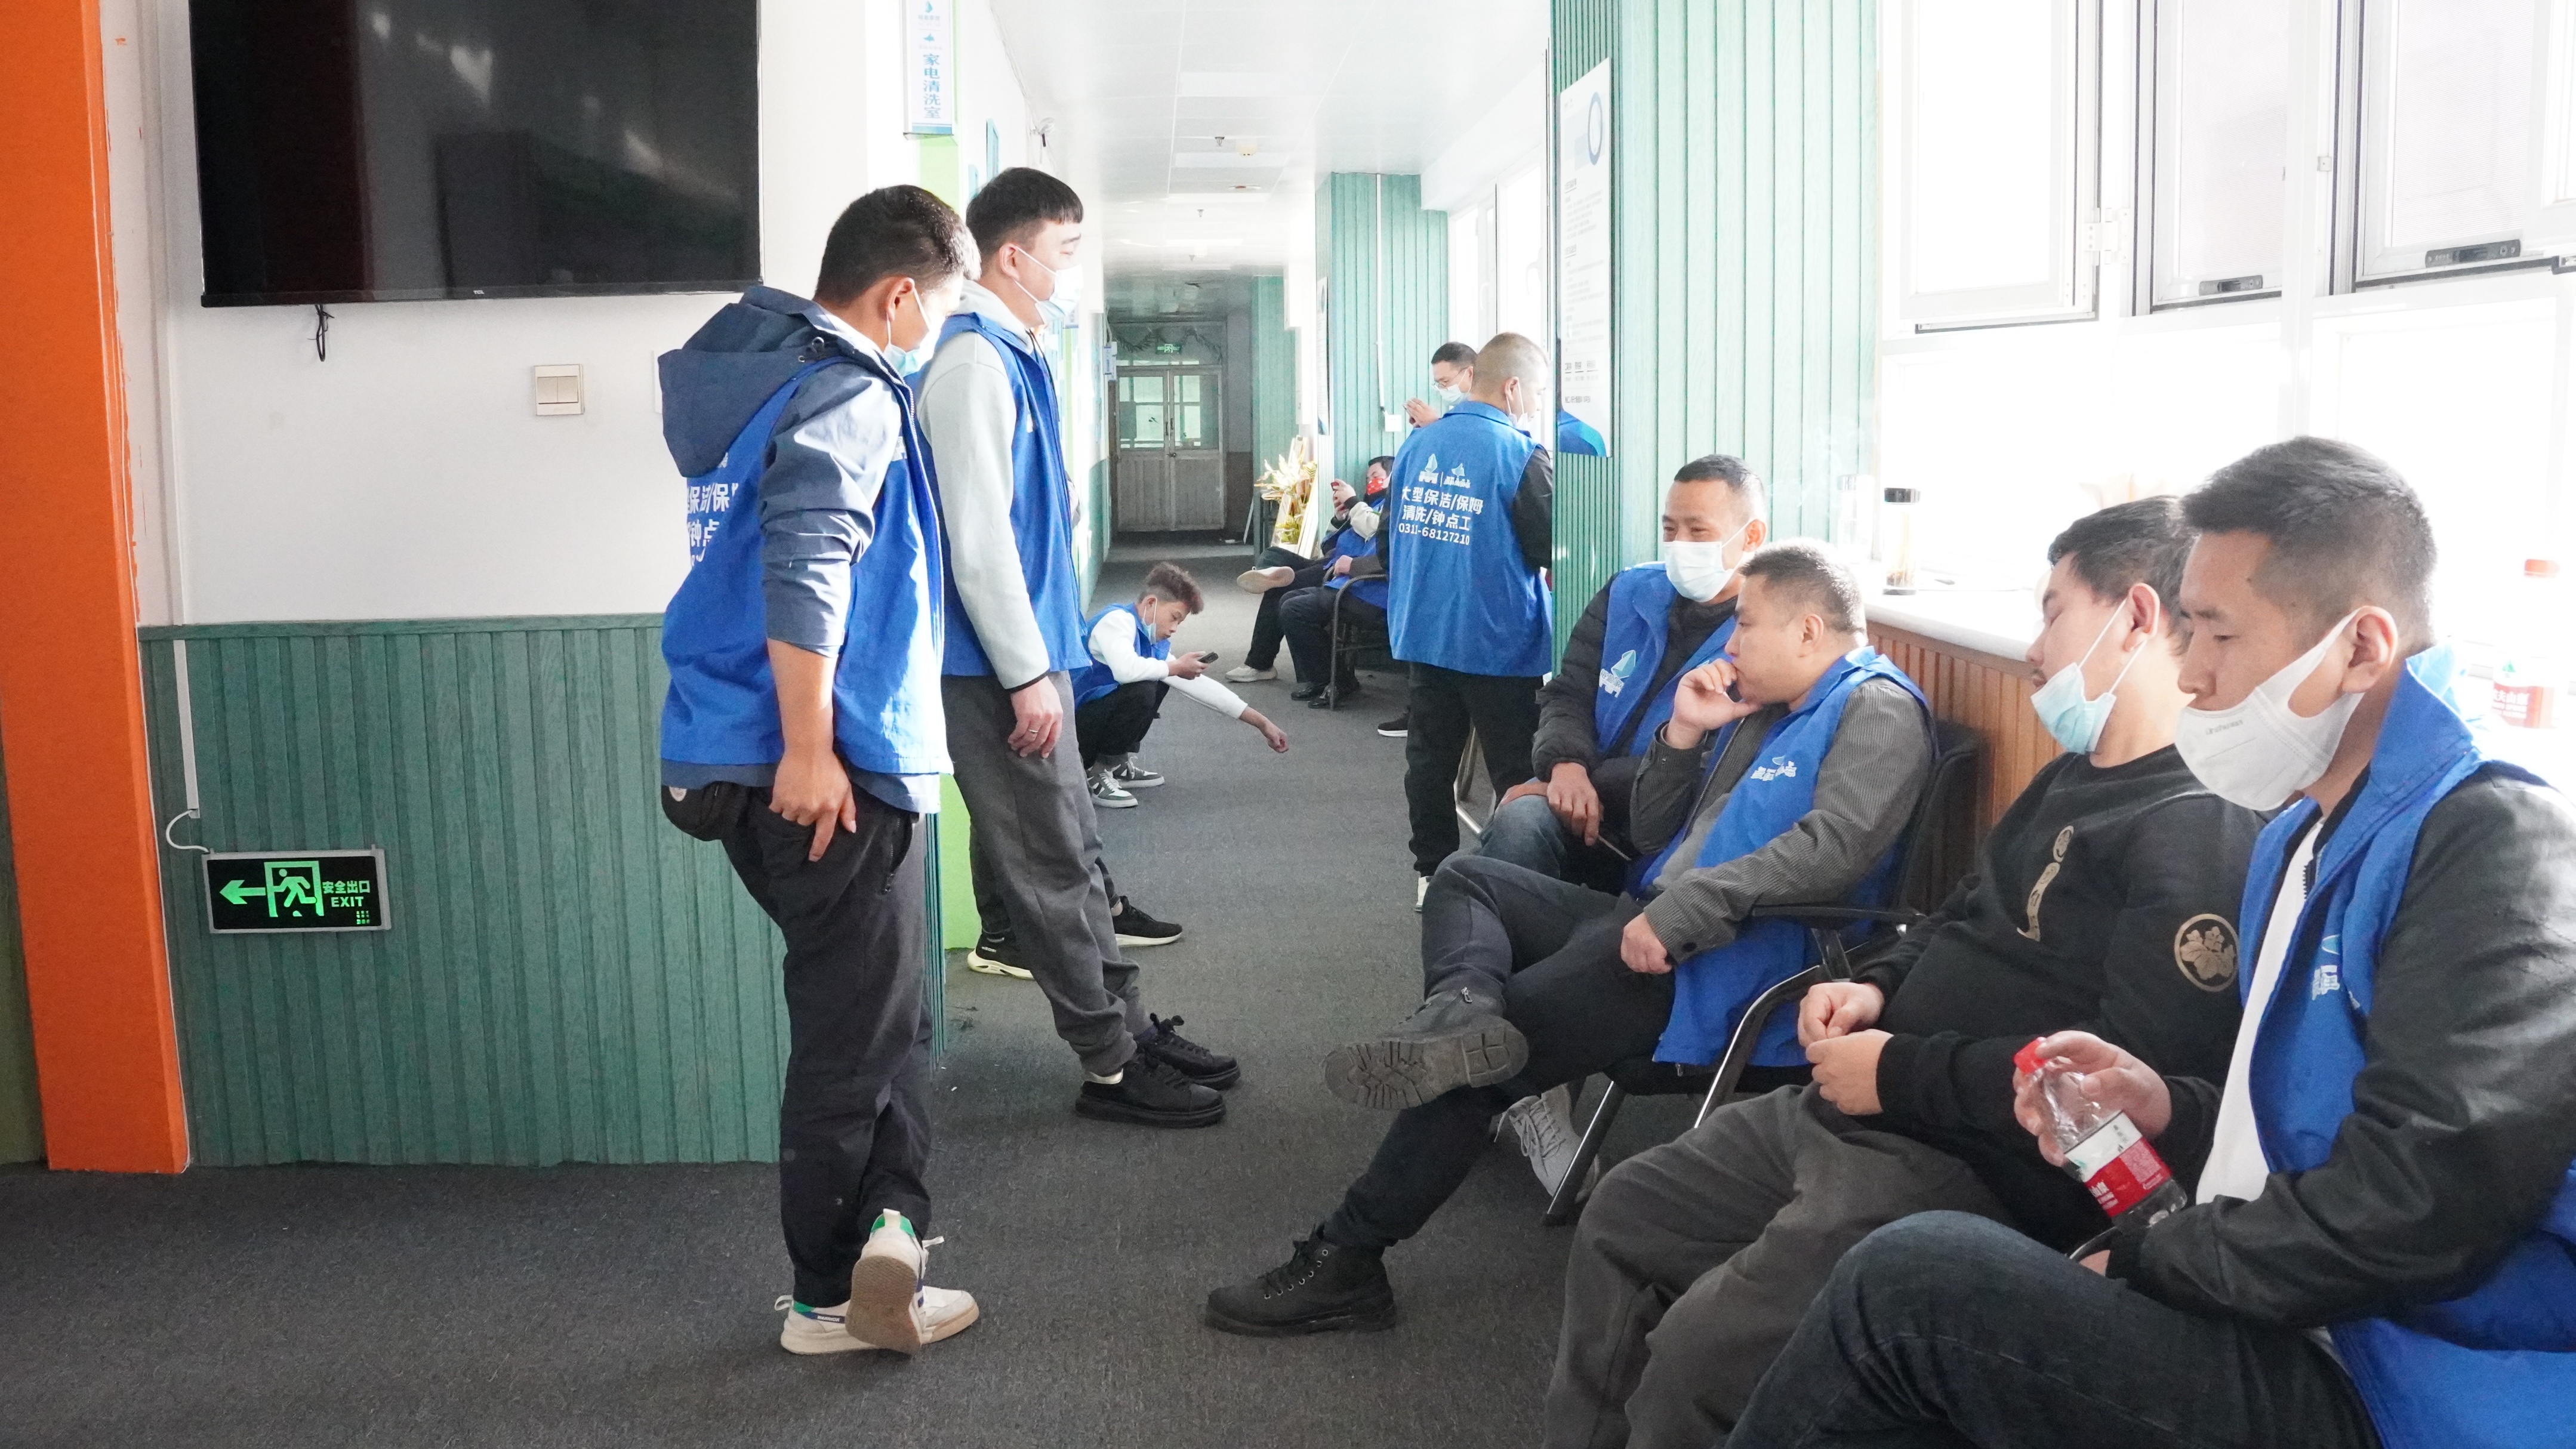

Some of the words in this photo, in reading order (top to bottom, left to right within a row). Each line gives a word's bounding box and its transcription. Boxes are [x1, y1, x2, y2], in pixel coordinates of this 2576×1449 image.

[923, 53, 941, 119] 家电清洗室
[1401, 486, 1484, 515] 大型保洁/保姆
[1401, 504, 1471, 531] 清洗/钟点工
[1398, 523, 1471, 545] 0311-68127210
[322, 880, 371, 895] 安全出口
[331, 896, 364, 908] EXIT
